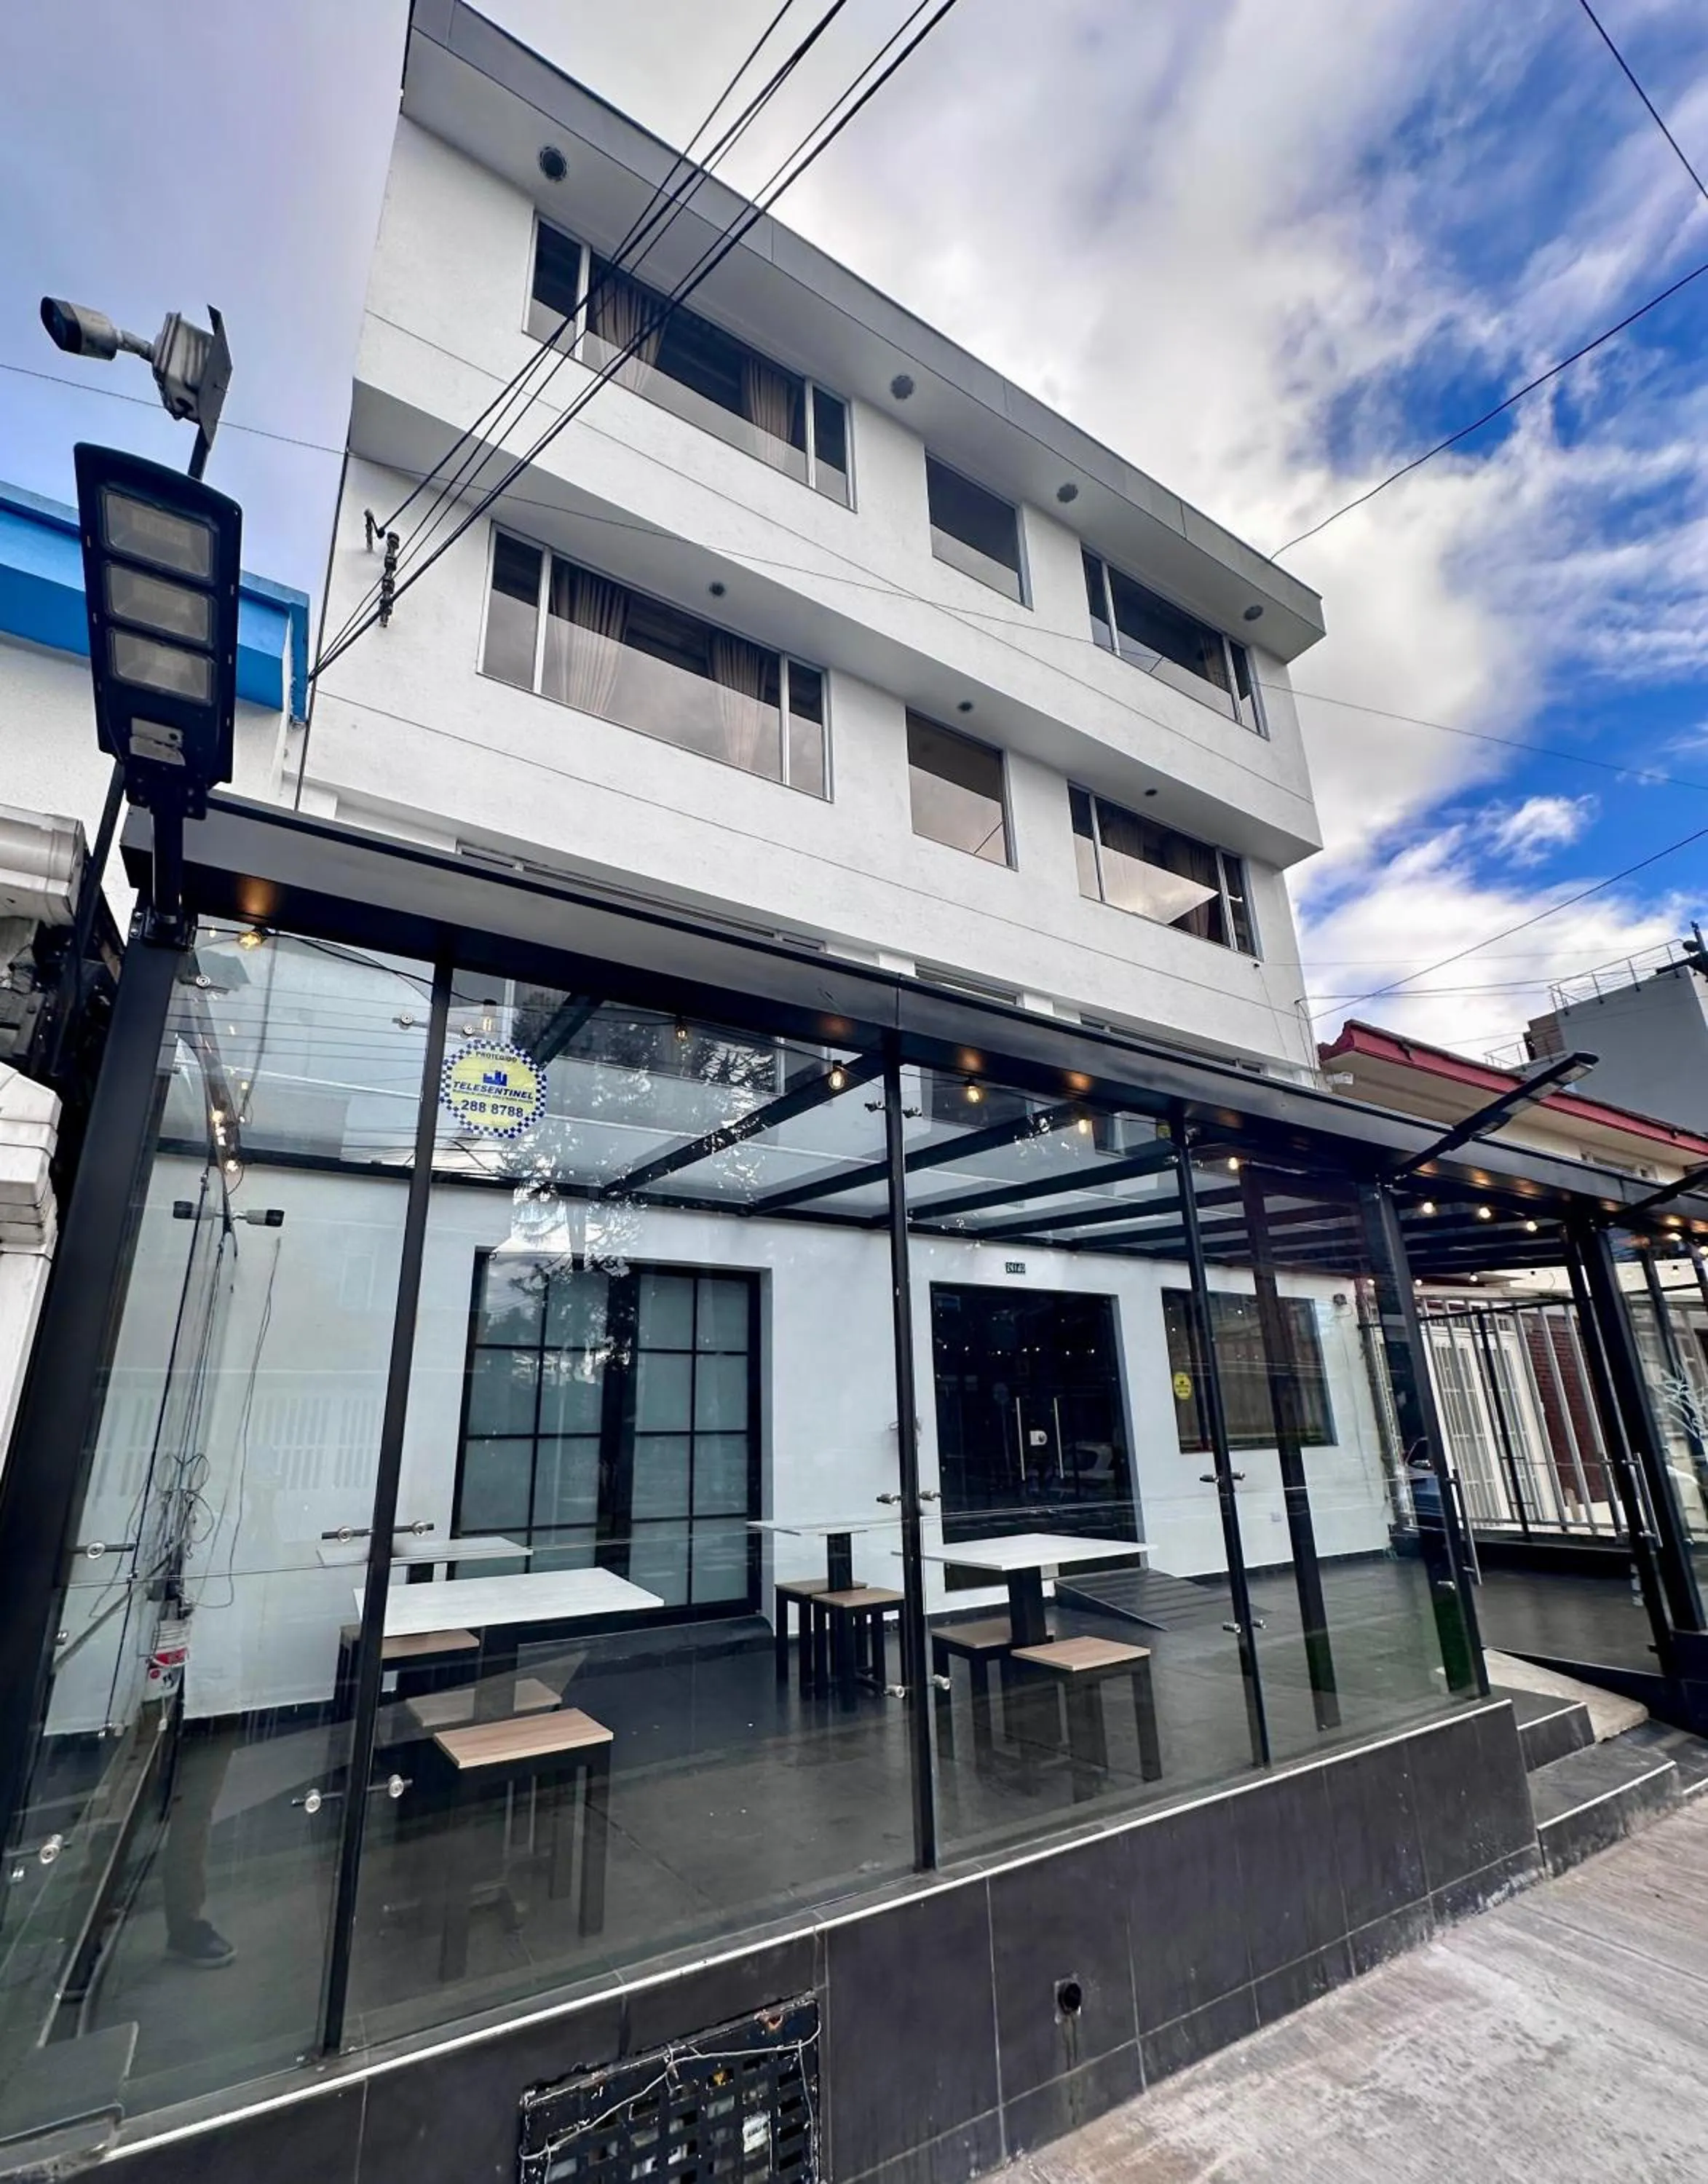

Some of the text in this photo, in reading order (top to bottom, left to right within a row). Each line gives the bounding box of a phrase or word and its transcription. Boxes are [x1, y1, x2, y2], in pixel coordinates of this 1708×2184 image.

[475, 1051, 518, 1063] PROTEGIDO
[453, 1081, 534, 1100] TELESENTINEL
[461, 1099, 523, 1118] 288 8788
